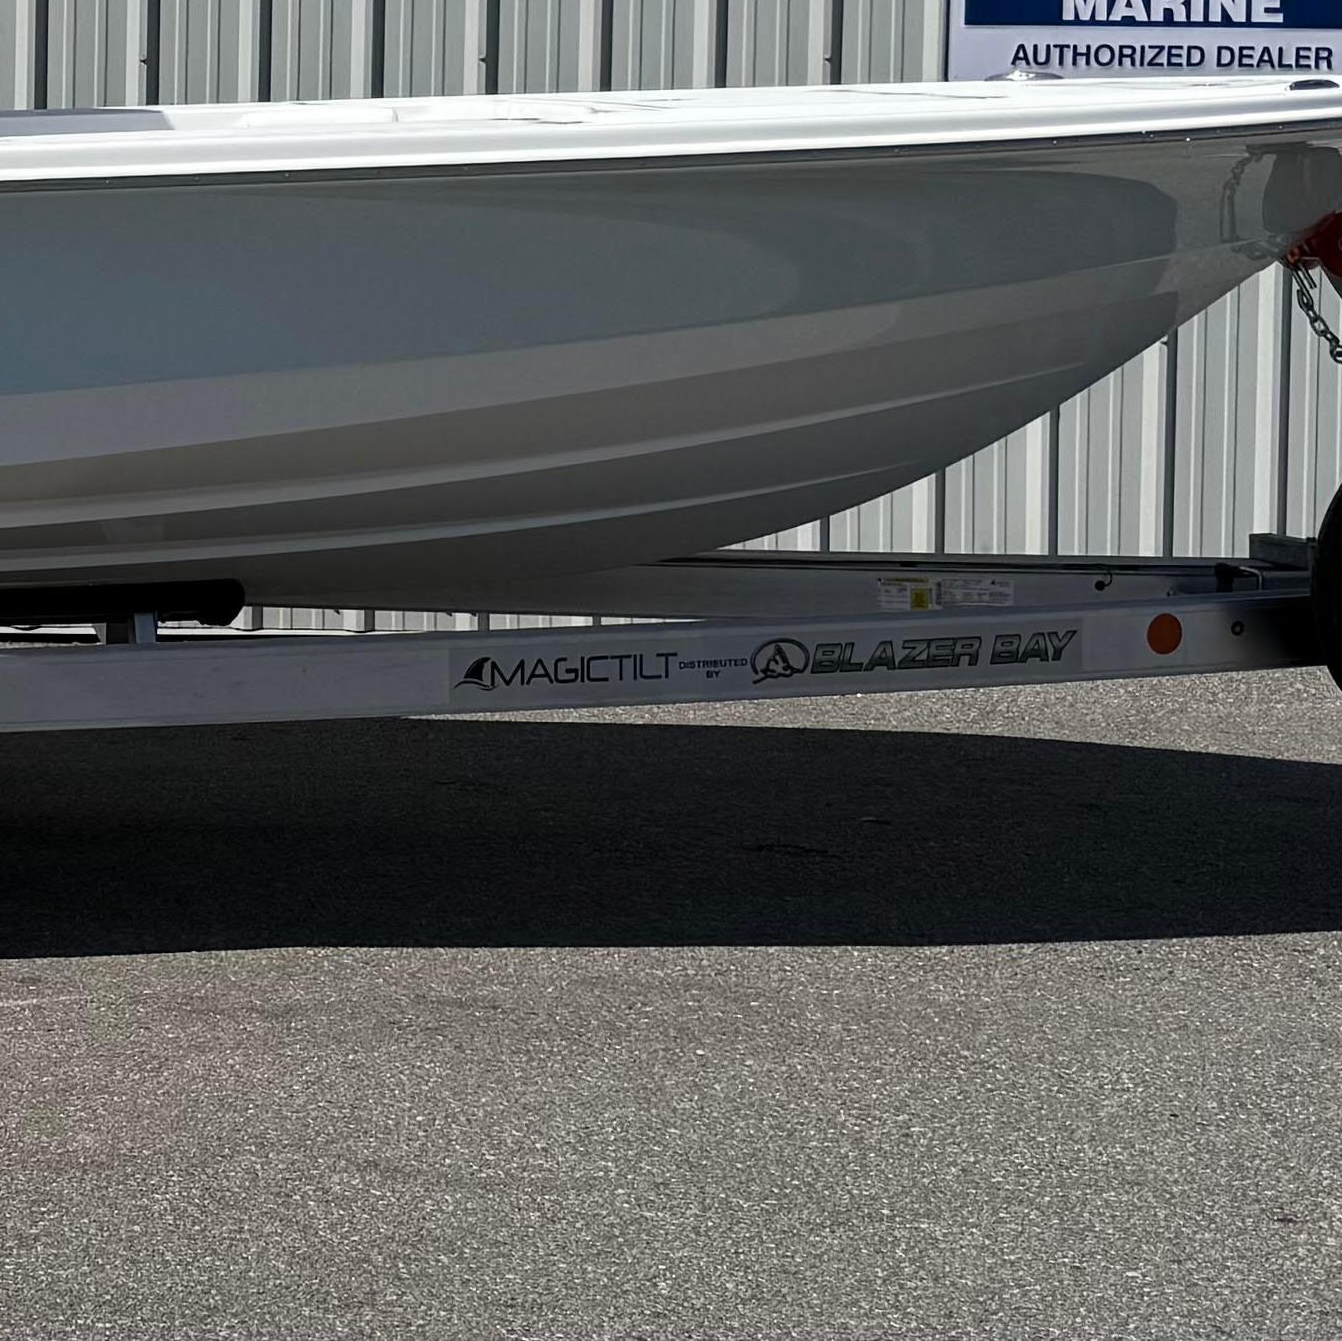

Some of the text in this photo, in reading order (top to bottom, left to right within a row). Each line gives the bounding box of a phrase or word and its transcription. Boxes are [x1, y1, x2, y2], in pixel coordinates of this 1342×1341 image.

[1011, 43, 1333, 71] AUTHORIZED DEALER
[679, 658, 748, 669] DISTRIBUTED
[810, 630, 1078, 675] BLAZER BAY
[490, 652, 678, 687] MAGICTILT
